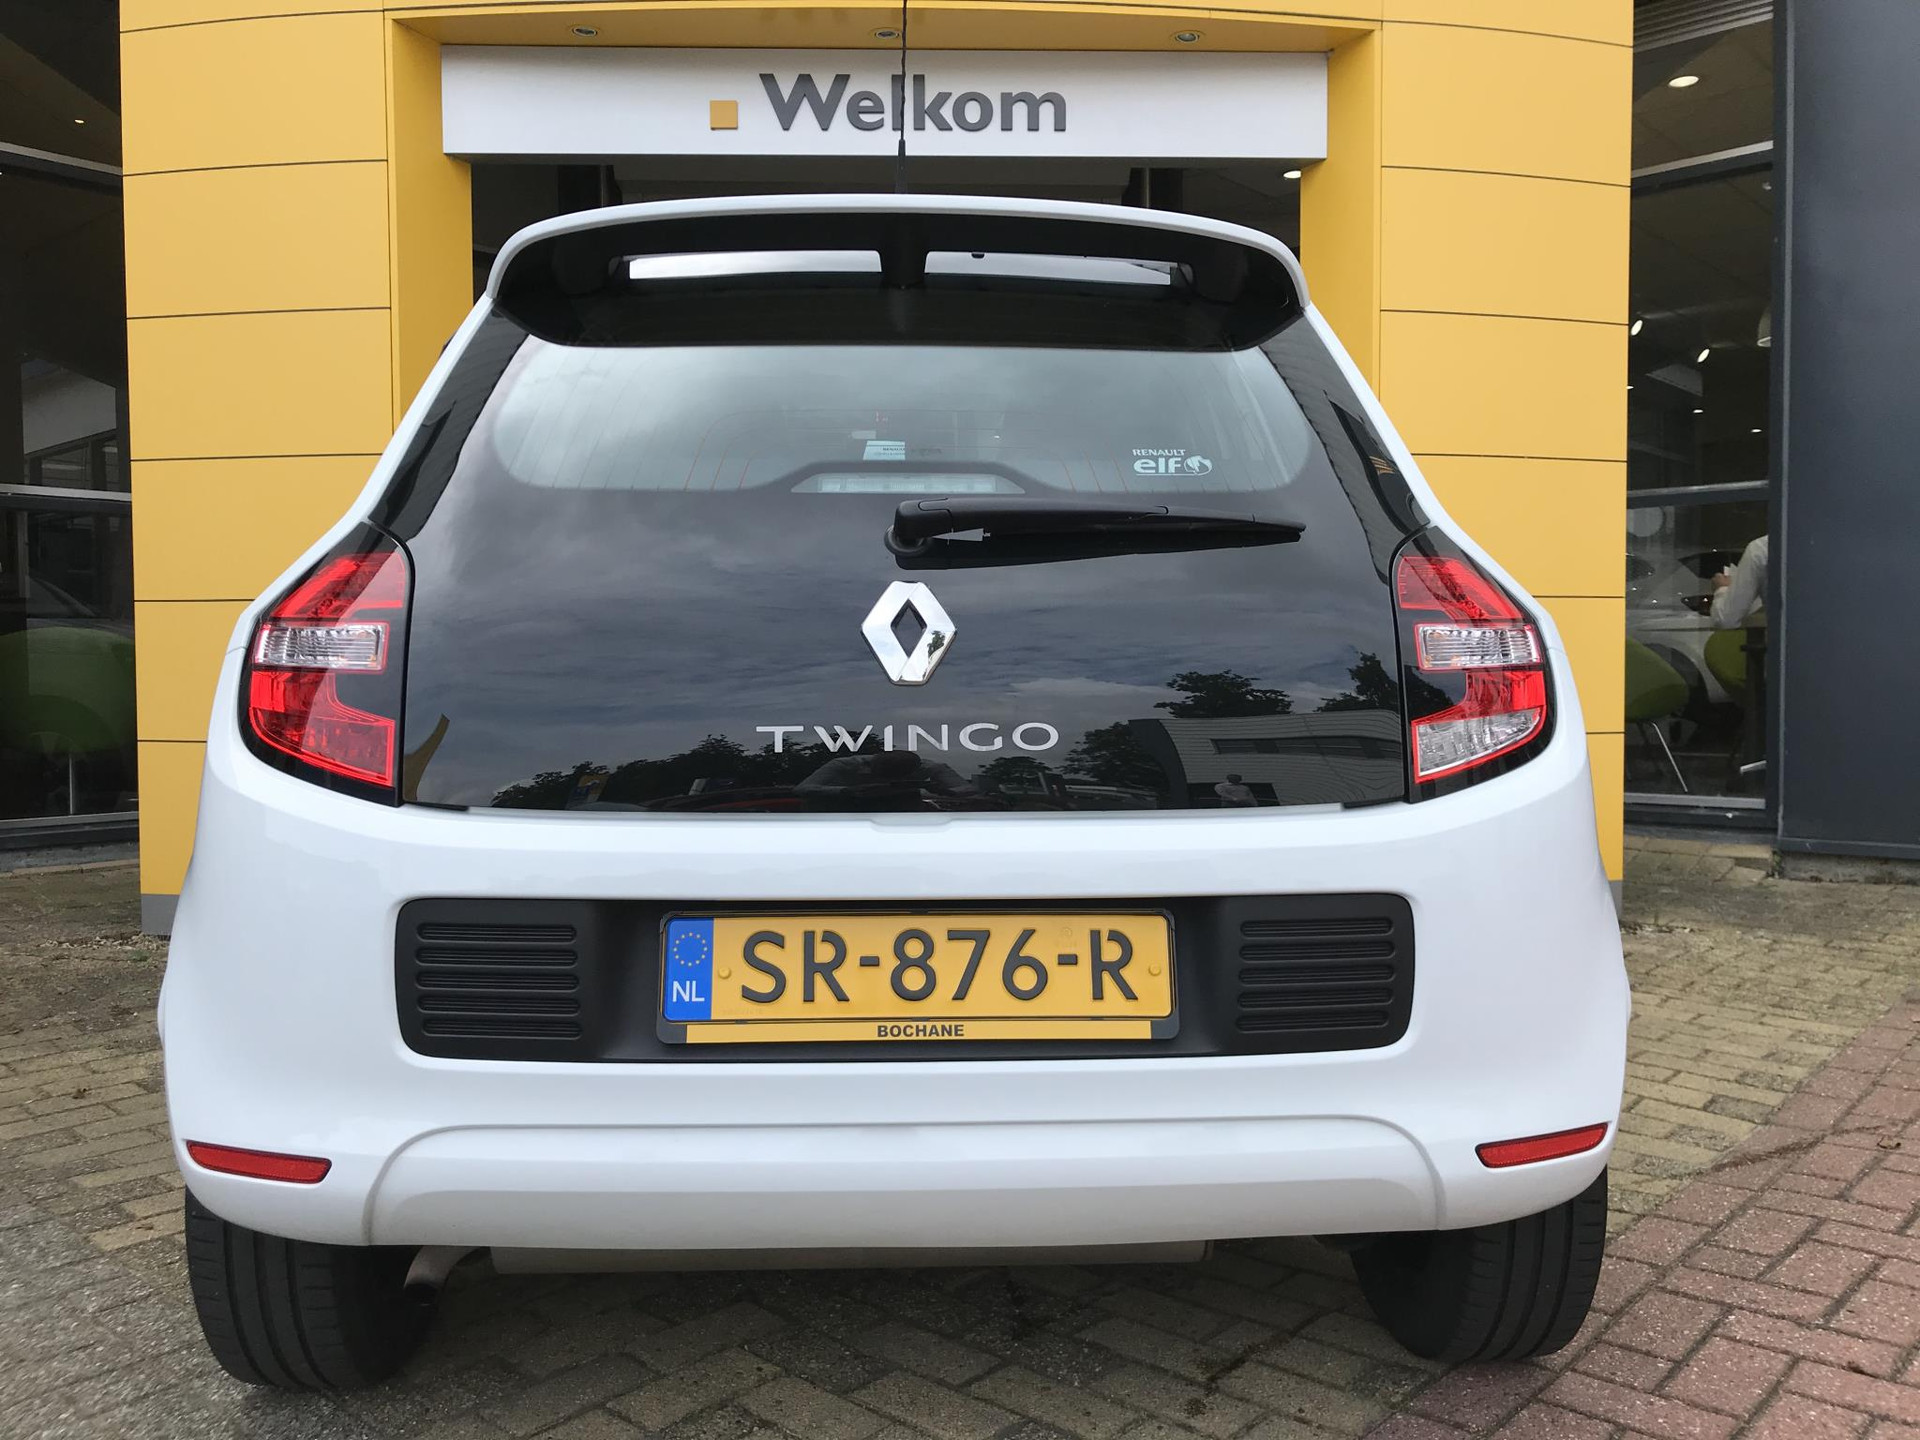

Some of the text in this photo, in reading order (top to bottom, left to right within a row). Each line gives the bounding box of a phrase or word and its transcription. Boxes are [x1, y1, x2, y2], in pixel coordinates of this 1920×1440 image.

[758, 73, 1067, 132] Welkom
[1132, 448, 1186, 457] RENAULT
[1133, 457, 1182, 473] elf
[755, 722, 1059, 753] TWINGO
[740, 929, 1139, 1004] SR-876-R
[672, 980, 705, 1002] NL
[877, 1024, 965, 1038] BOCHANE
